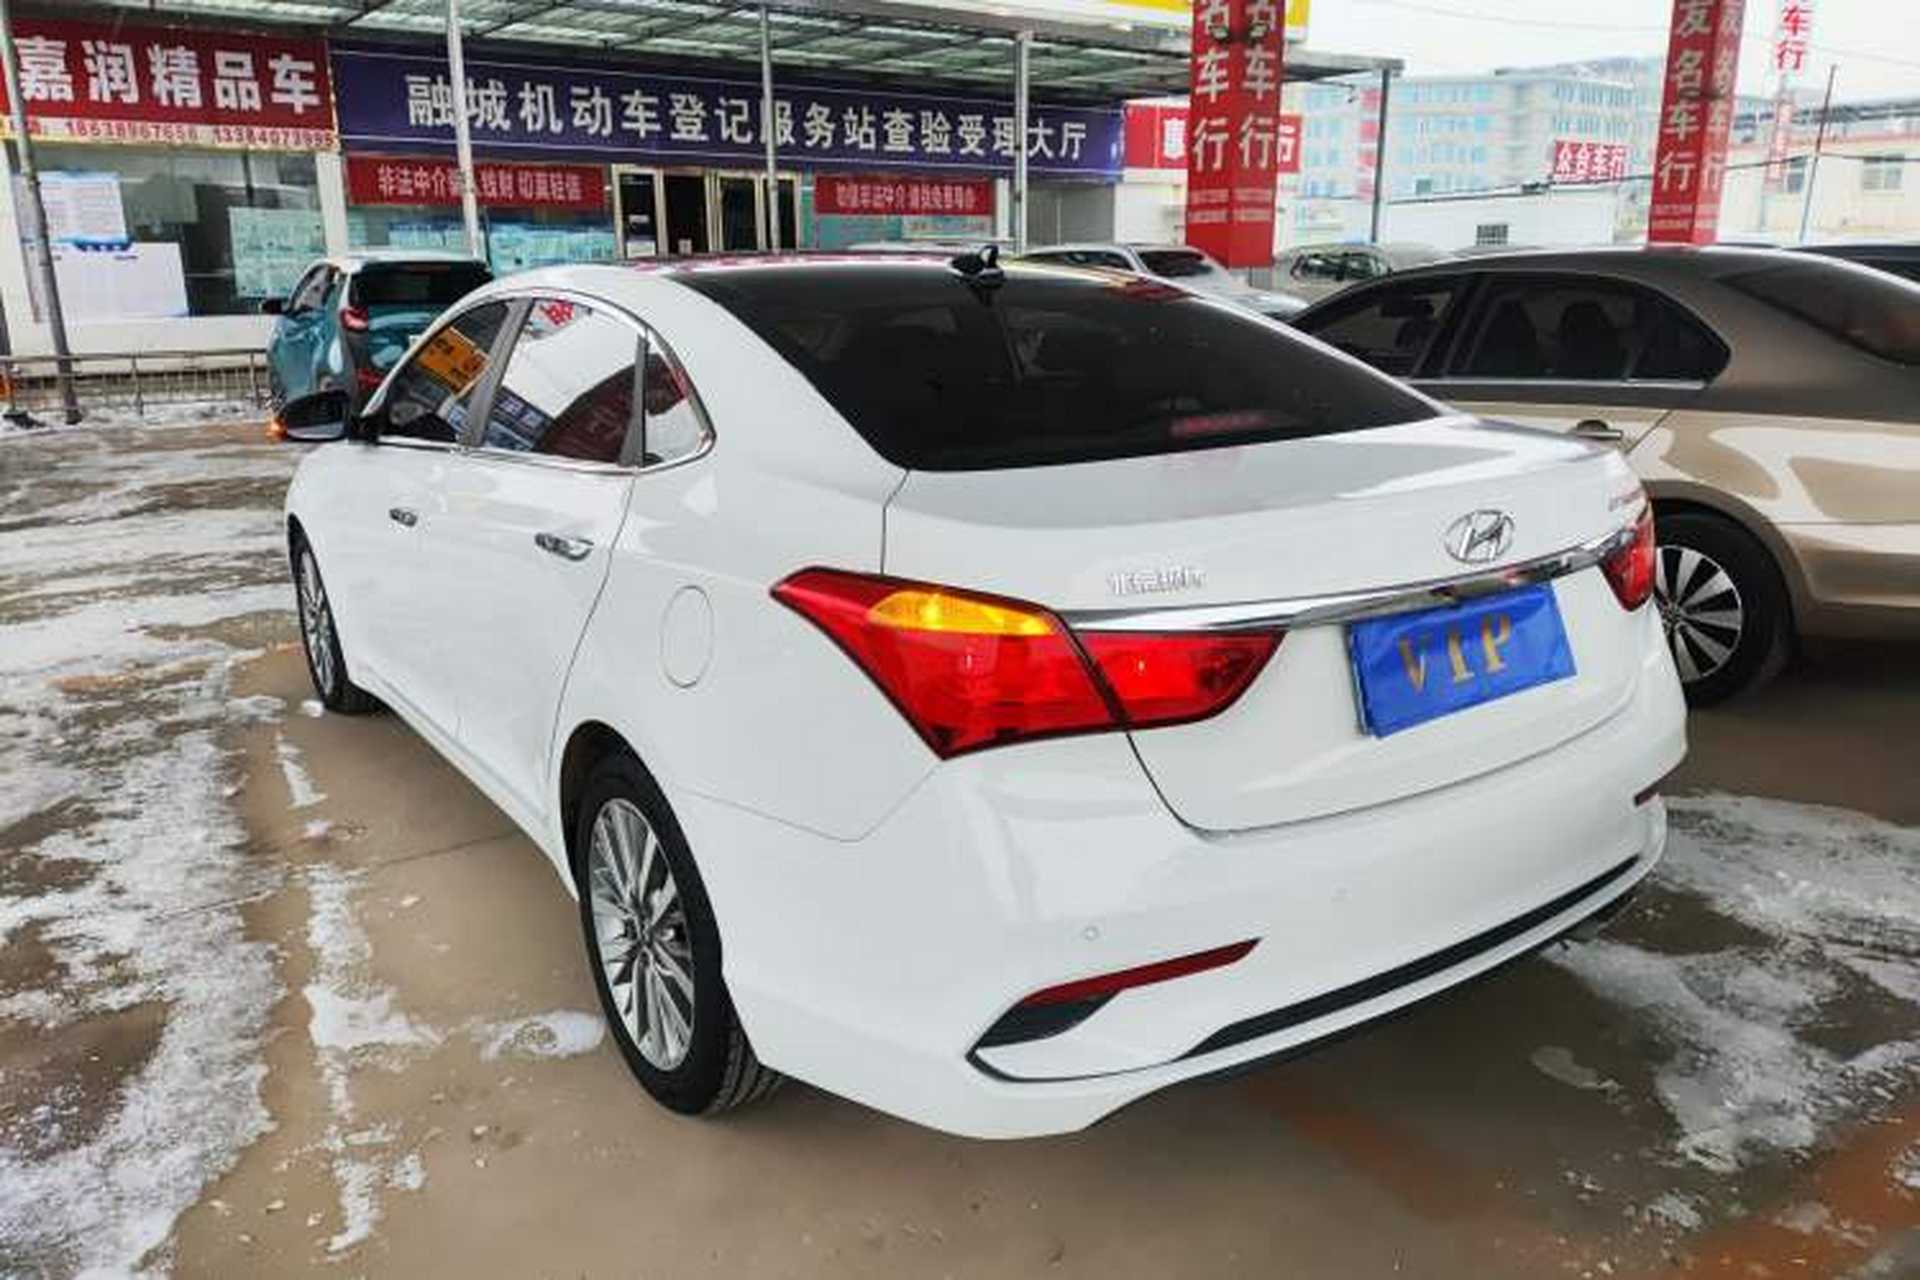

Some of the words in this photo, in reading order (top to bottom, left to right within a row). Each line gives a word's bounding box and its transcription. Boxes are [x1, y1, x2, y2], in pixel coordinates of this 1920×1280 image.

[13, 36, 321, 114] 嘉润精品车
[404, 74, 1086, 161] 融城机动车登记服务站查验受理大厅
[1398, 613, 1512, 695] VIP
